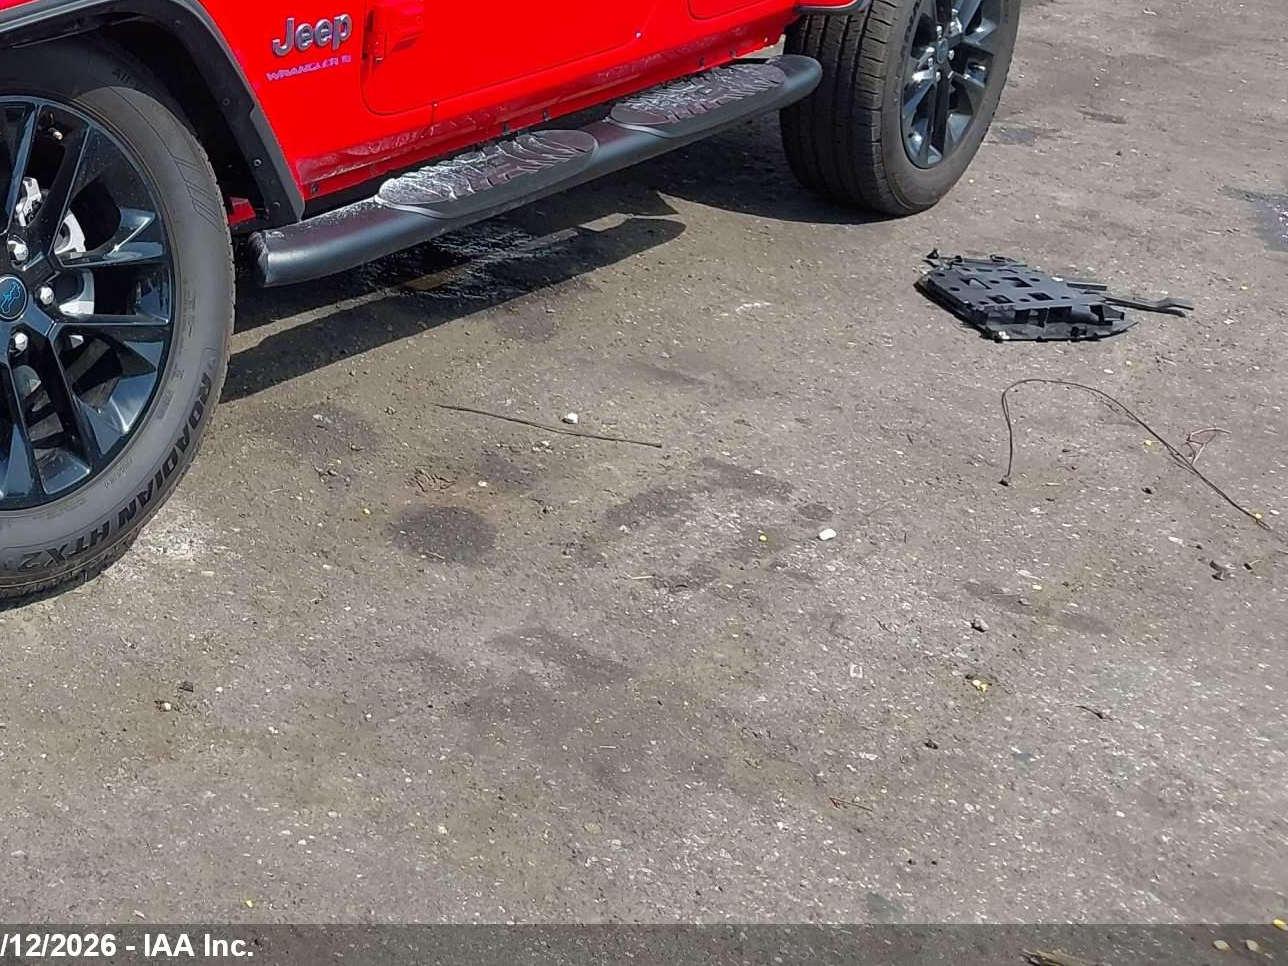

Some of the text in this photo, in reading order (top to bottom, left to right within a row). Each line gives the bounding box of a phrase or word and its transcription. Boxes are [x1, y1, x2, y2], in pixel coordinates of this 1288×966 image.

[272, 13, 353, 57] Jeep
[16, 372, 214, 573] ROADIAN HTX2
